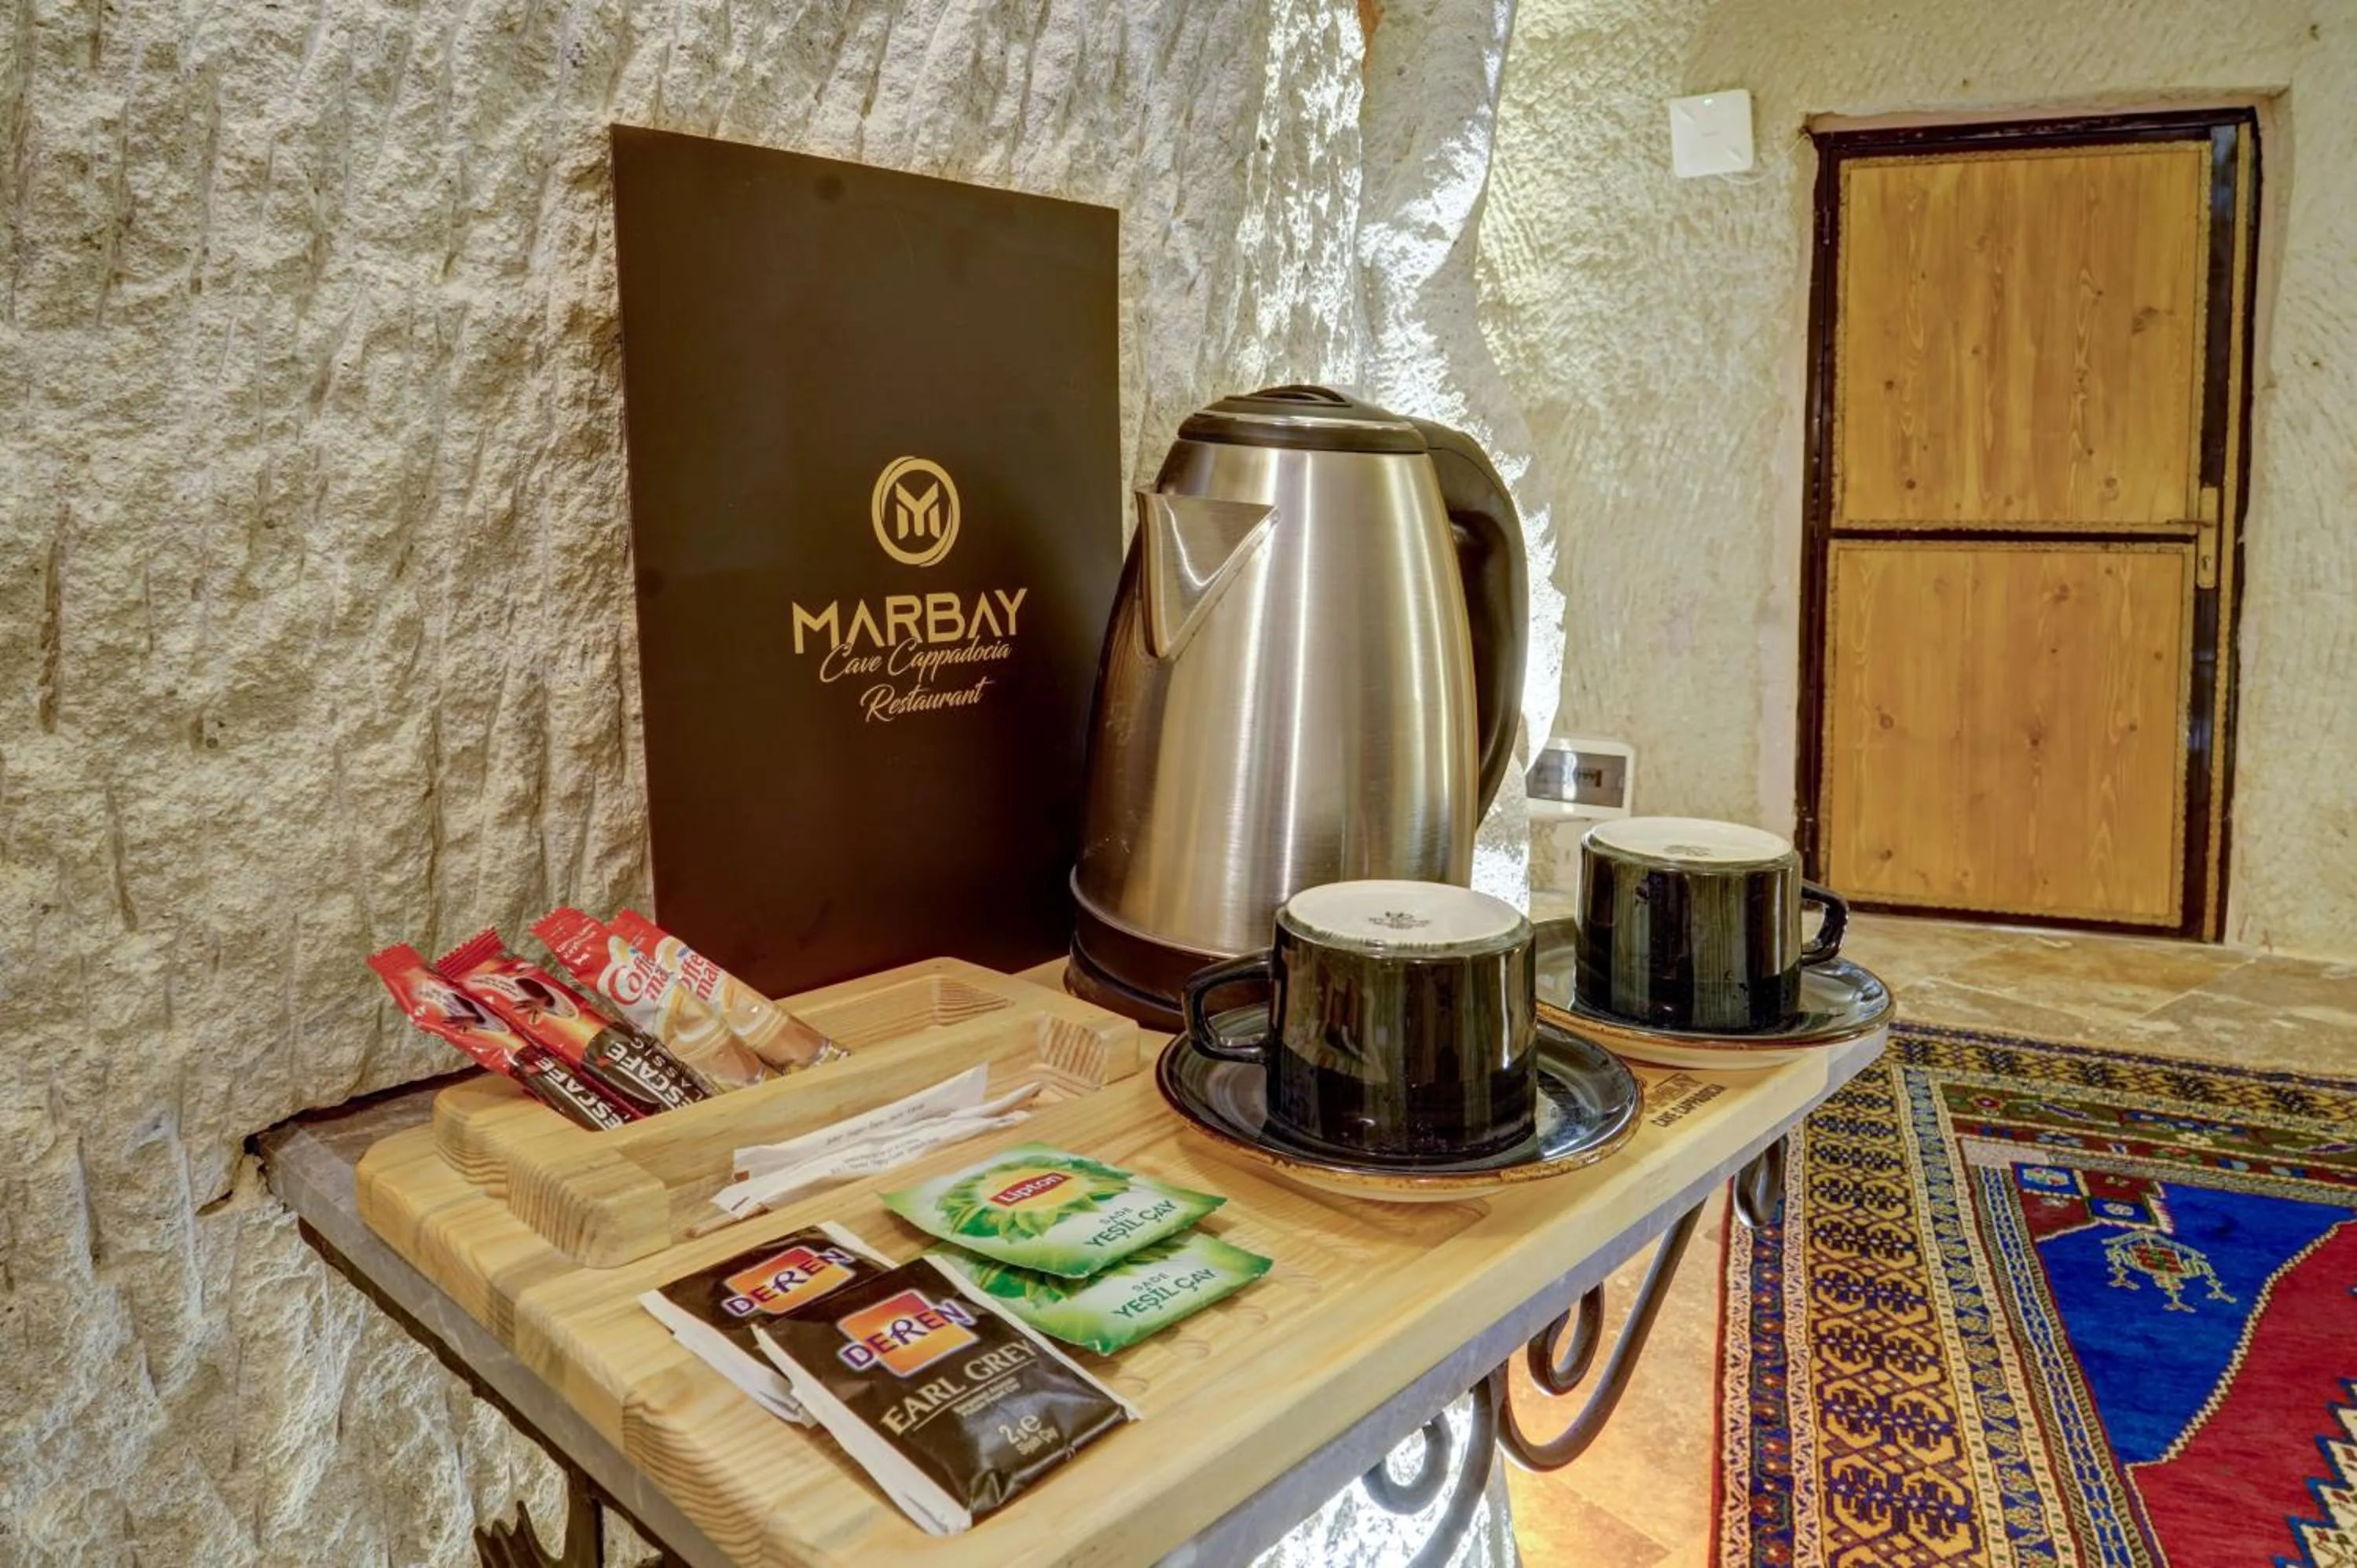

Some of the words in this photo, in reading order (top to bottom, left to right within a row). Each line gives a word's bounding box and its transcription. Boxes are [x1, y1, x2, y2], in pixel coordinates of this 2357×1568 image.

[792, 588, 1028, 654] MARBAY
[819, 643, 882, 683] Cave
[887, 636, 1011, 682] Cappadocia
[860, 676, 996, 723] Restaurant
[631, 1037, 703, 1104] LASSIC
[998, 1175, 1063, 1203] Lipton
[1138, 1200, 1177, 1224] ÇAY
[727, 1249, 852, 1314] DEREN
[1174, 1269, 1216, 1291] ÇAY
[842, 1301, 974, 1368] DEREN
[879, 1377, 967, 1436] EARL
[964, 1339, 1037, 1380] GREY
